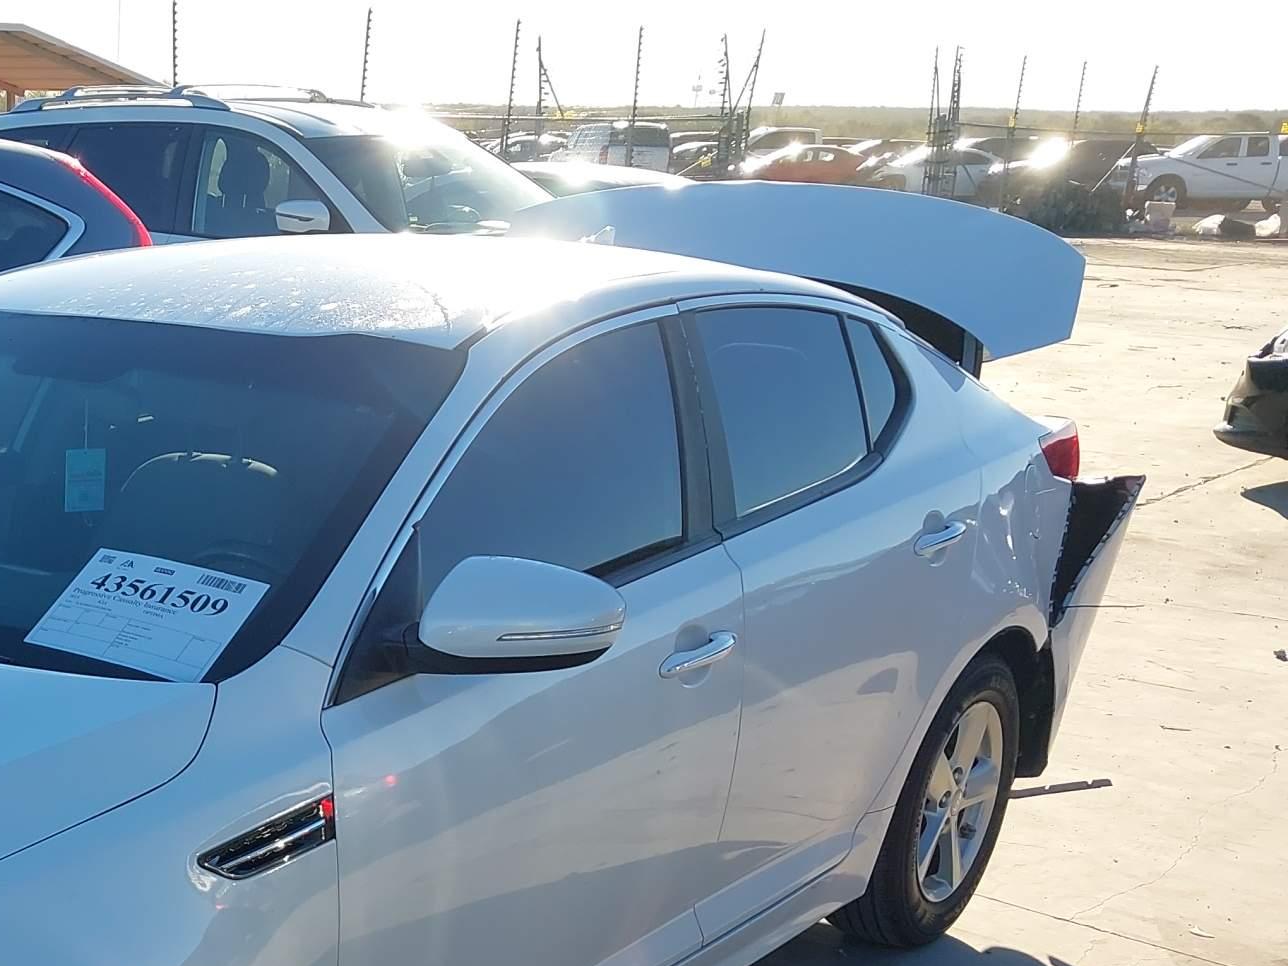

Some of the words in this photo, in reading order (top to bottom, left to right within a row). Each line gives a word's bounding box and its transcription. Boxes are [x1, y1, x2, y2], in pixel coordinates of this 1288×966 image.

[73, 587, 112, 600] Progressive
[144, 602, 176, 616] Insurance
[91, 573, 228, 616] 43561509
